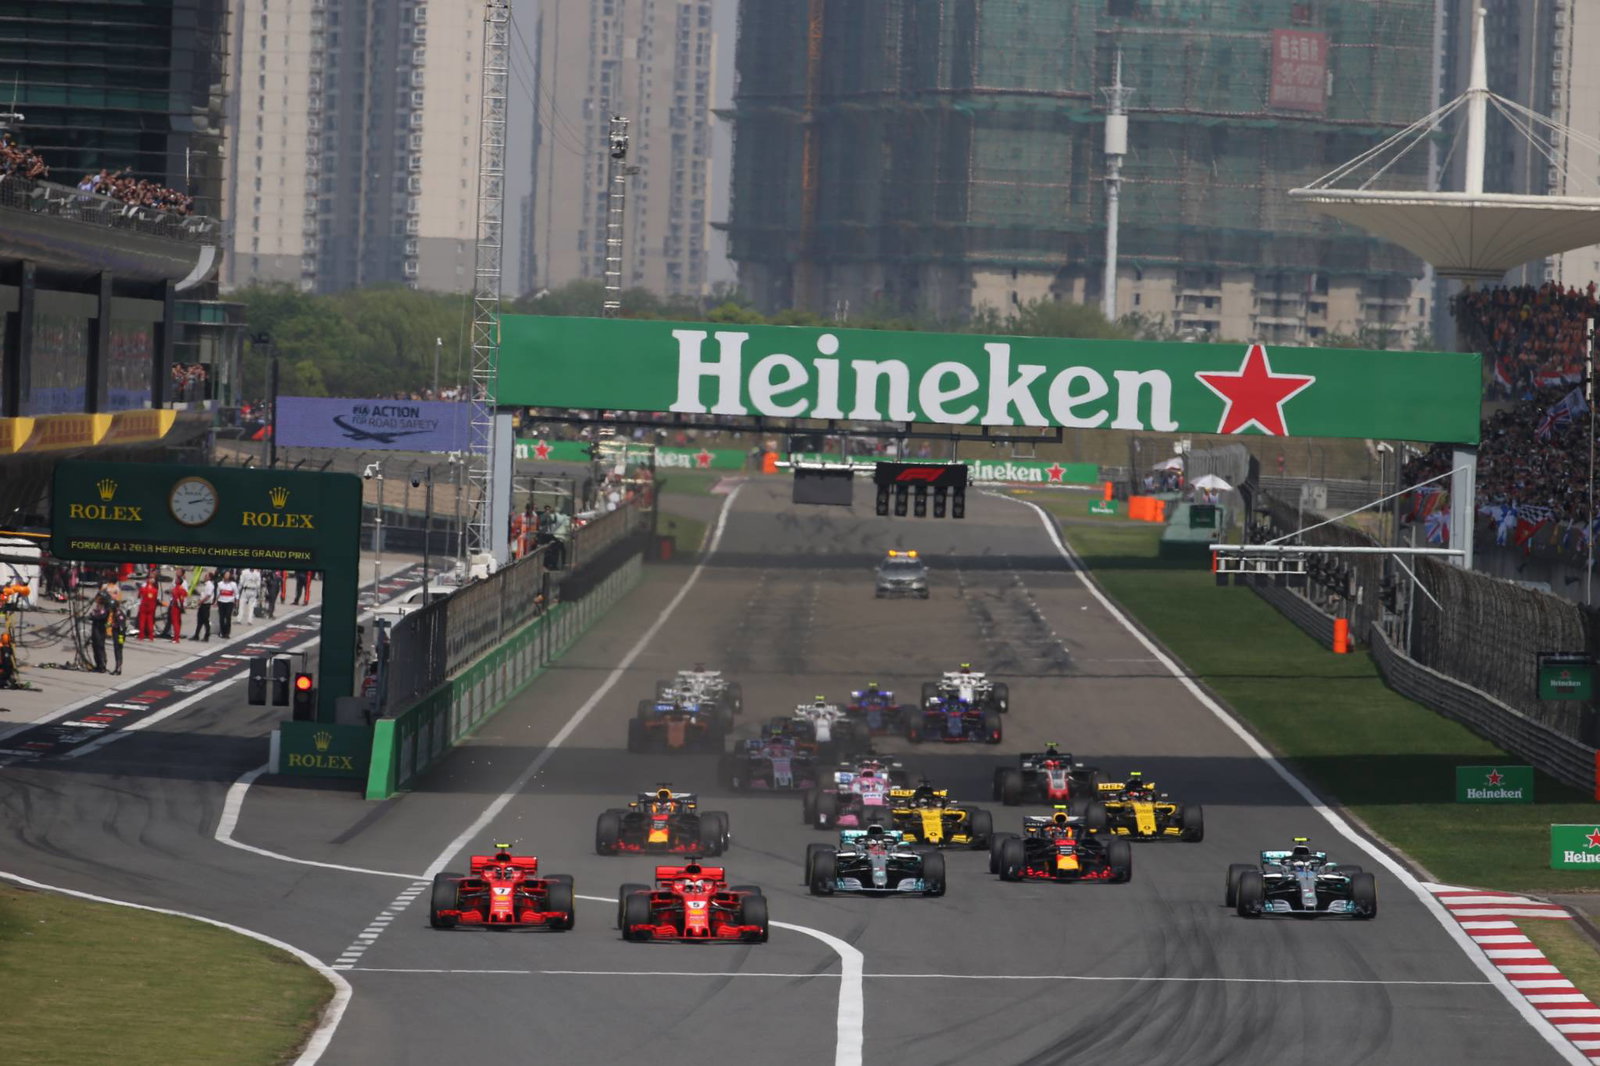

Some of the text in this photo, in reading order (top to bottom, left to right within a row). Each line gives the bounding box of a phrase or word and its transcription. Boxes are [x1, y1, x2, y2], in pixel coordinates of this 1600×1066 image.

[669, 329, 1179, 432] Heineken
[352, 406, 420, 418] FIA ACTION
[352, 415, 439, 430] FOR ROAD SAFETY
[967, 460, 1043, 482] eineken
[70, 503, 142, 521] ROLEX
[242, 511, 315, 529] ROLEX
[71, 541, 120, 551] FORMULA
[129, 543, 153, 553] 2018
[155, 545, 206, 556] HEINEKEN
[208, 547, 250, 558] CHINESE
[251, 549, 287, 559] GRAND
[288, 551, 311, 561] PRIX
[288, 753, 353, 770] ROLEX
[1467, 788, 1522, 799] Heineken
